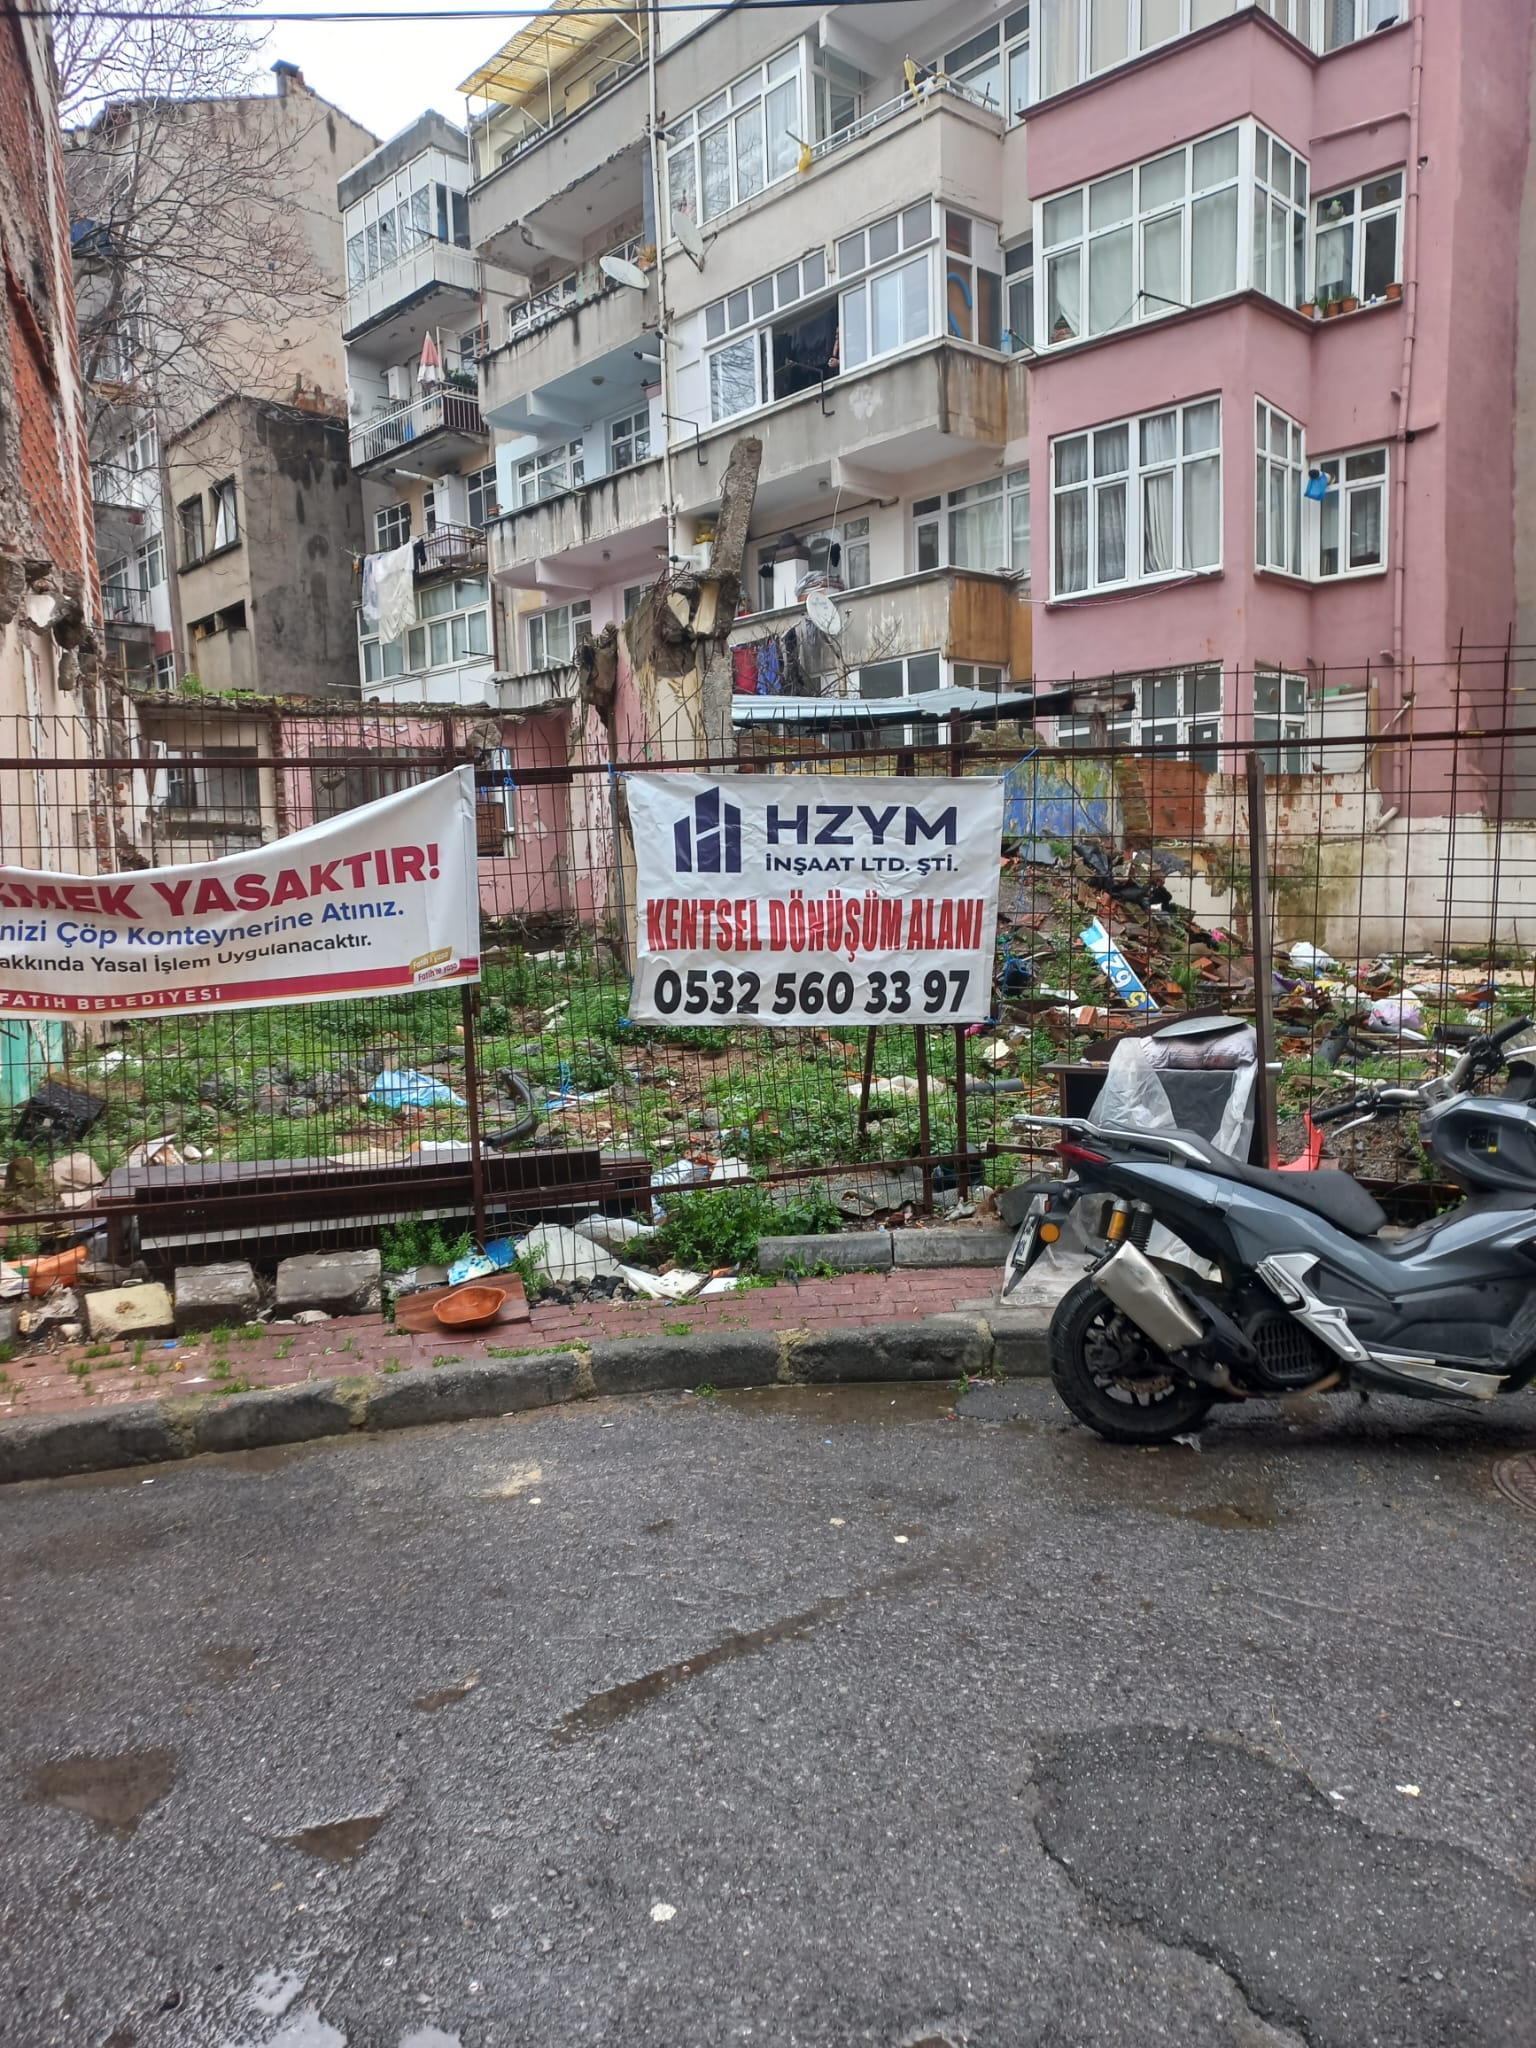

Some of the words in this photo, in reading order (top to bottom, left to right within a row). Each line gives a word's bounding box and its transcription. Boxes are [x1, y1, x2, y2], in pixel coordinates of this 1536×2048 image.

[766, 805, 958, 846] HZYM
[150, 843, 440, 916] YASAKTIR!
[766, 853, 855, 875] İNŞAAT
[861, 857, 910, 871] LTD.
[919, 854, 958, 876] ŞTİ.
[57, 921, 117, 949] Çöp
[128, 911, 313, 948] Konteynerine
[321, 901, 404, 923] Atınız.
[647, 899, 763, 952] KENTSEL
[769, 889, 902, 962] DÖNÜŞÜM
[907, 899, 984, 951] ALANI
[91, 956, 147, 972] Yasal
[154, 955, 210, 975] İşlem
[217, 934, 372, 964] Uygulanacaktır.
[654, 970, 761, 1014] 0532
[772, 971, 855, 1015] 560
[864, 970, 911, 1014] 33
[923, 970, 970, 1012] 97
